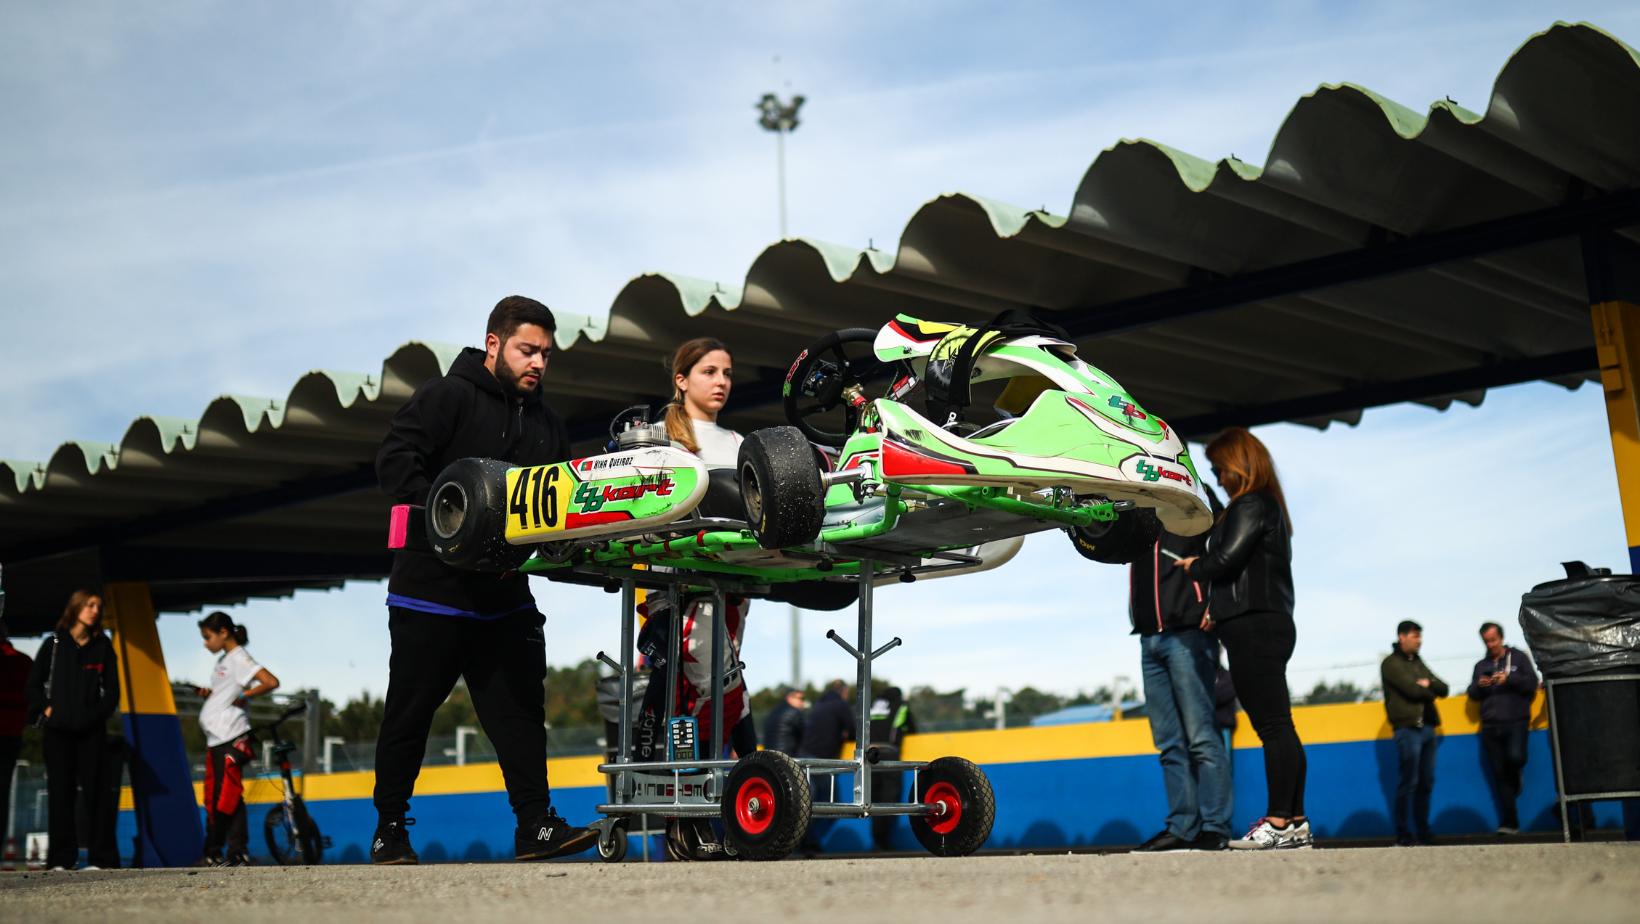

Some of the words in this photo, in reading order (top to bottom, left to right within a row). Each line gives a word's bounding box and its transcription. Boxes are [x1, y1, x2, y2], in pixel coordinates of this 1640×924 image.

[1135, 459, 1192, 486] tbkart
[509, 466, 560, 530] 416
[573, 479, 676, 514] tbkart
[537, 826, 554, 841] N
